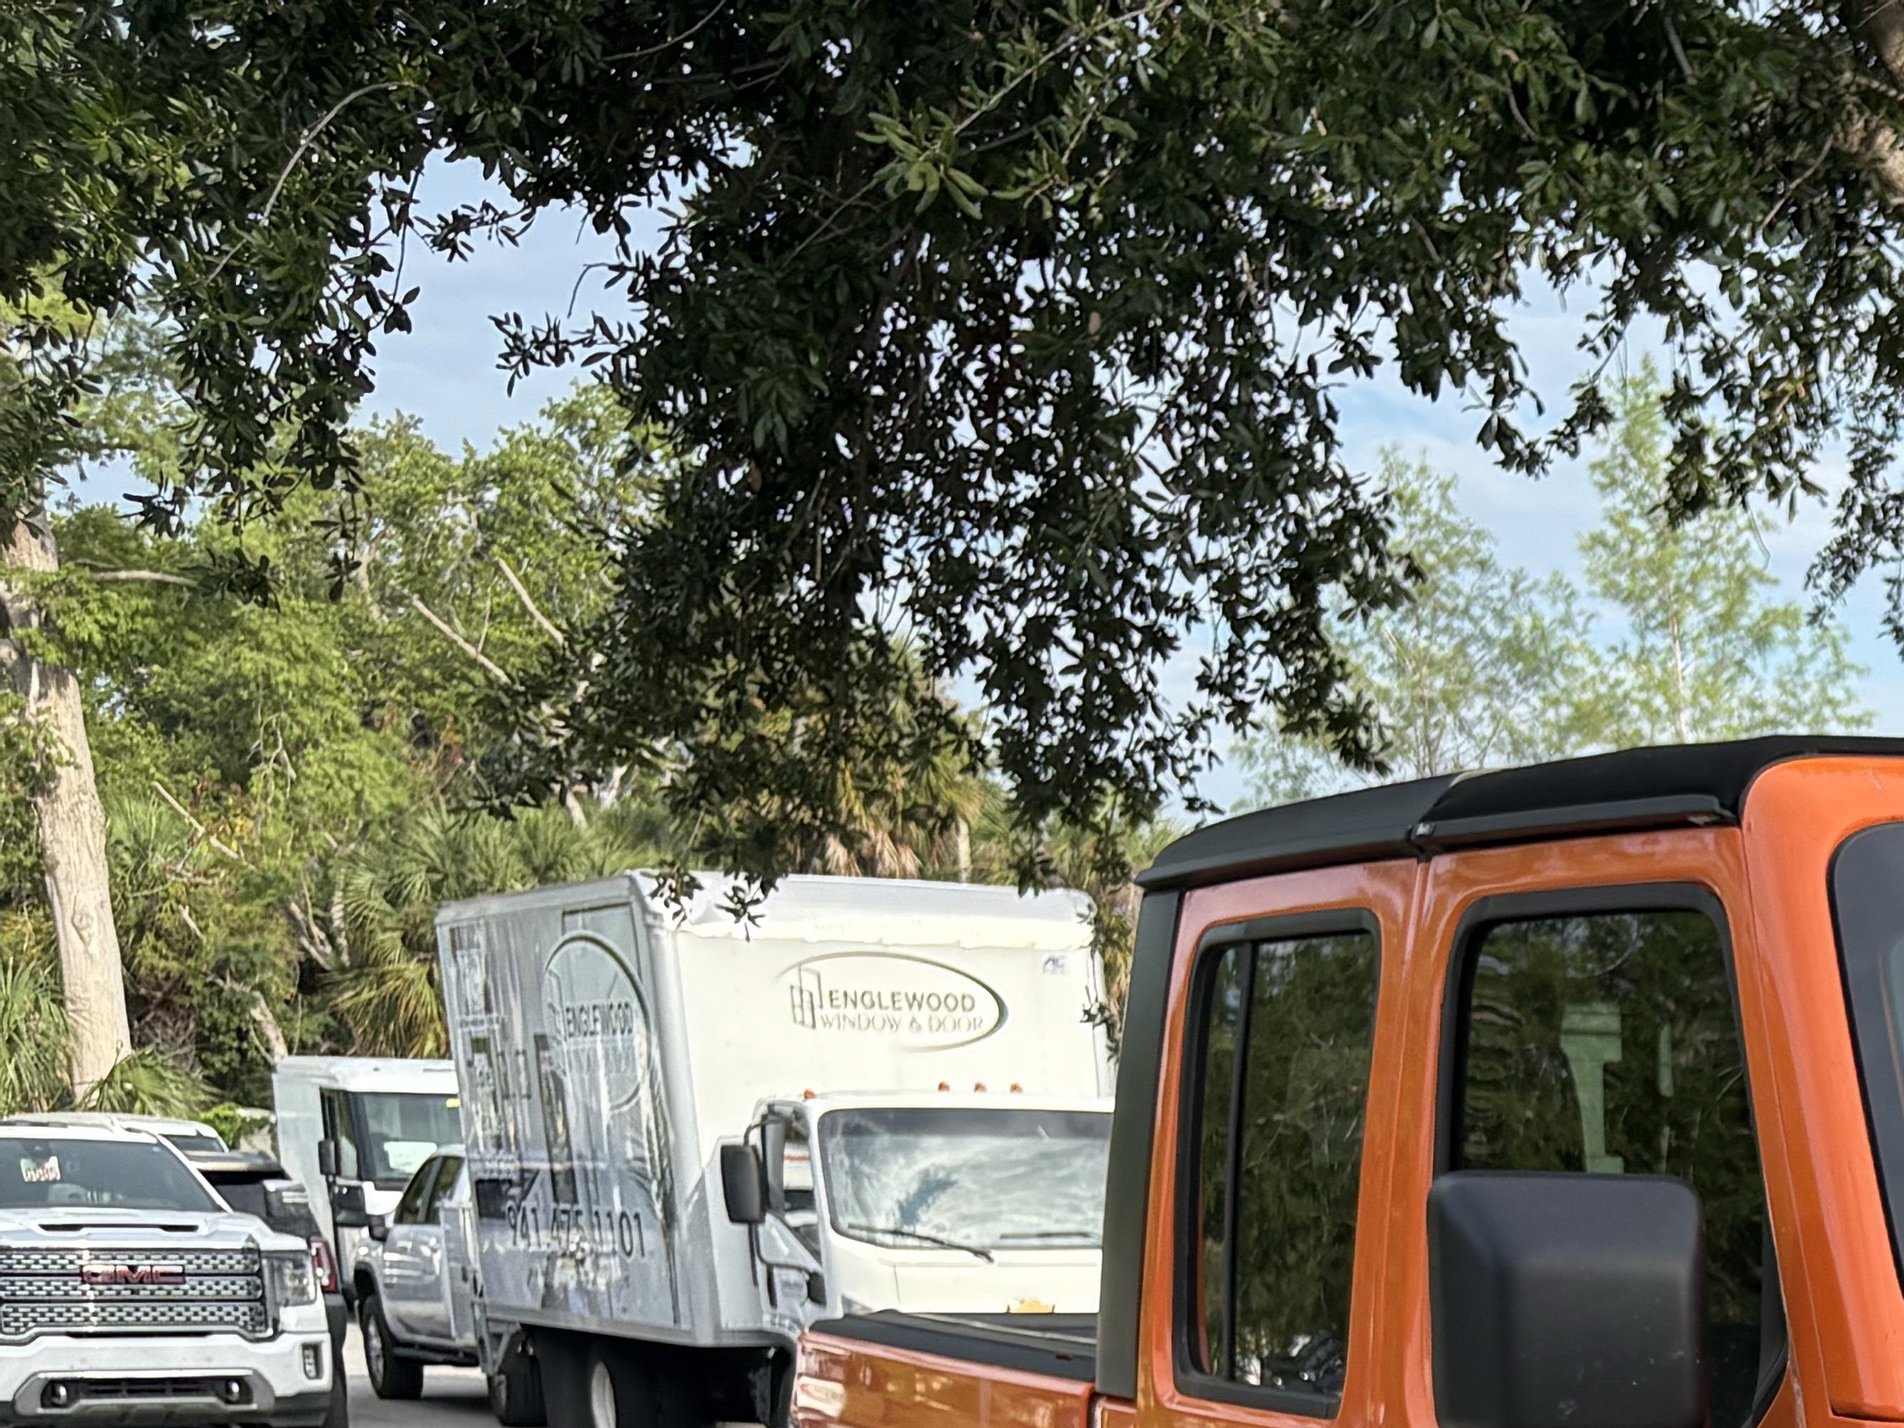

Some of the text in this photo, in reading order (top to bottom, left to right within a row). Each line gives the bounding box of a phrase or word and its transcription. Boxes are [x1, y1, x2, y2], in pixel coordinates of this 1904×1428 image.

[829, 989, 976, 1013] ENGLEWOOD
[821, 1012, 983, 1034] WINDOW & DOOR
[82, 1264, 184, 1284] GMC
